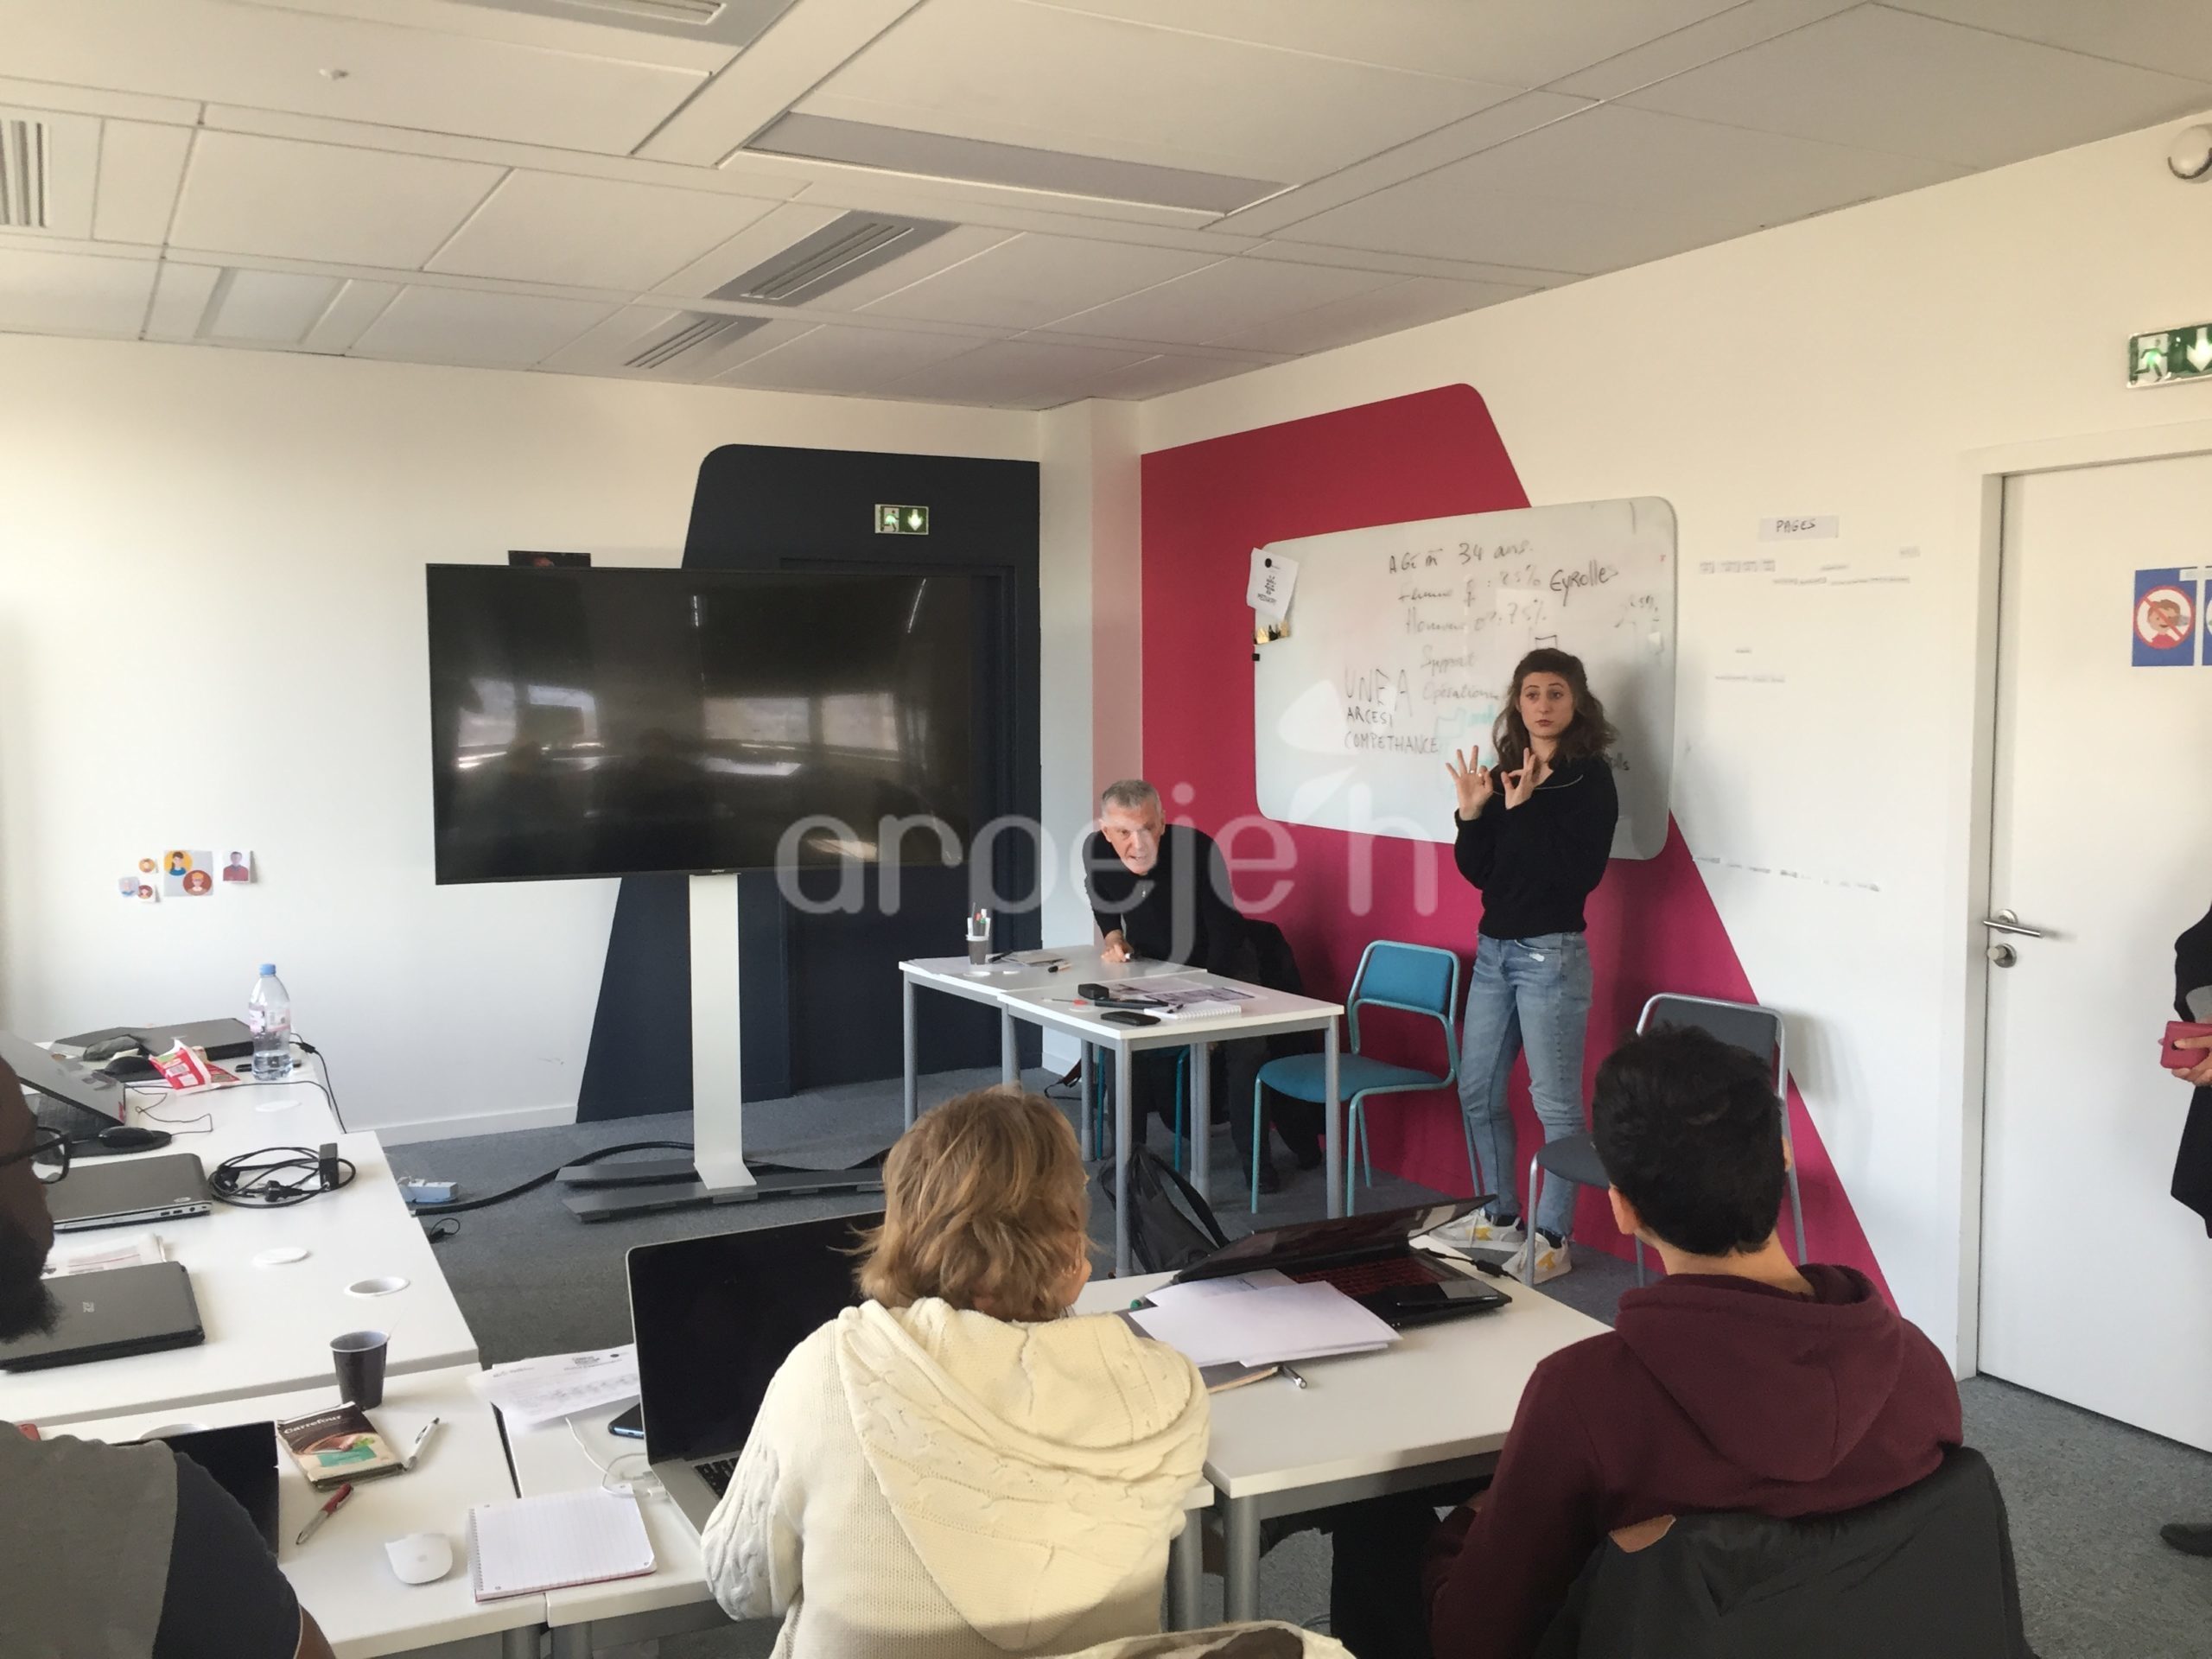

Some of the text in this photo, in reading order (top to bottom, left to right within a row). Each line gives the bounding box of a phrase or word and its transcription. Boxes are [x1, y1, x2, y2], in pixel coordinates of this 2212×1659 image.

[1776, 518, 1816, 533] PAGES
[1458, 542, 1484, 565] 34
[1344, 730, 1439, 755] COMPETHANCE
[283, 1414, 342, 1434] Carrefour
